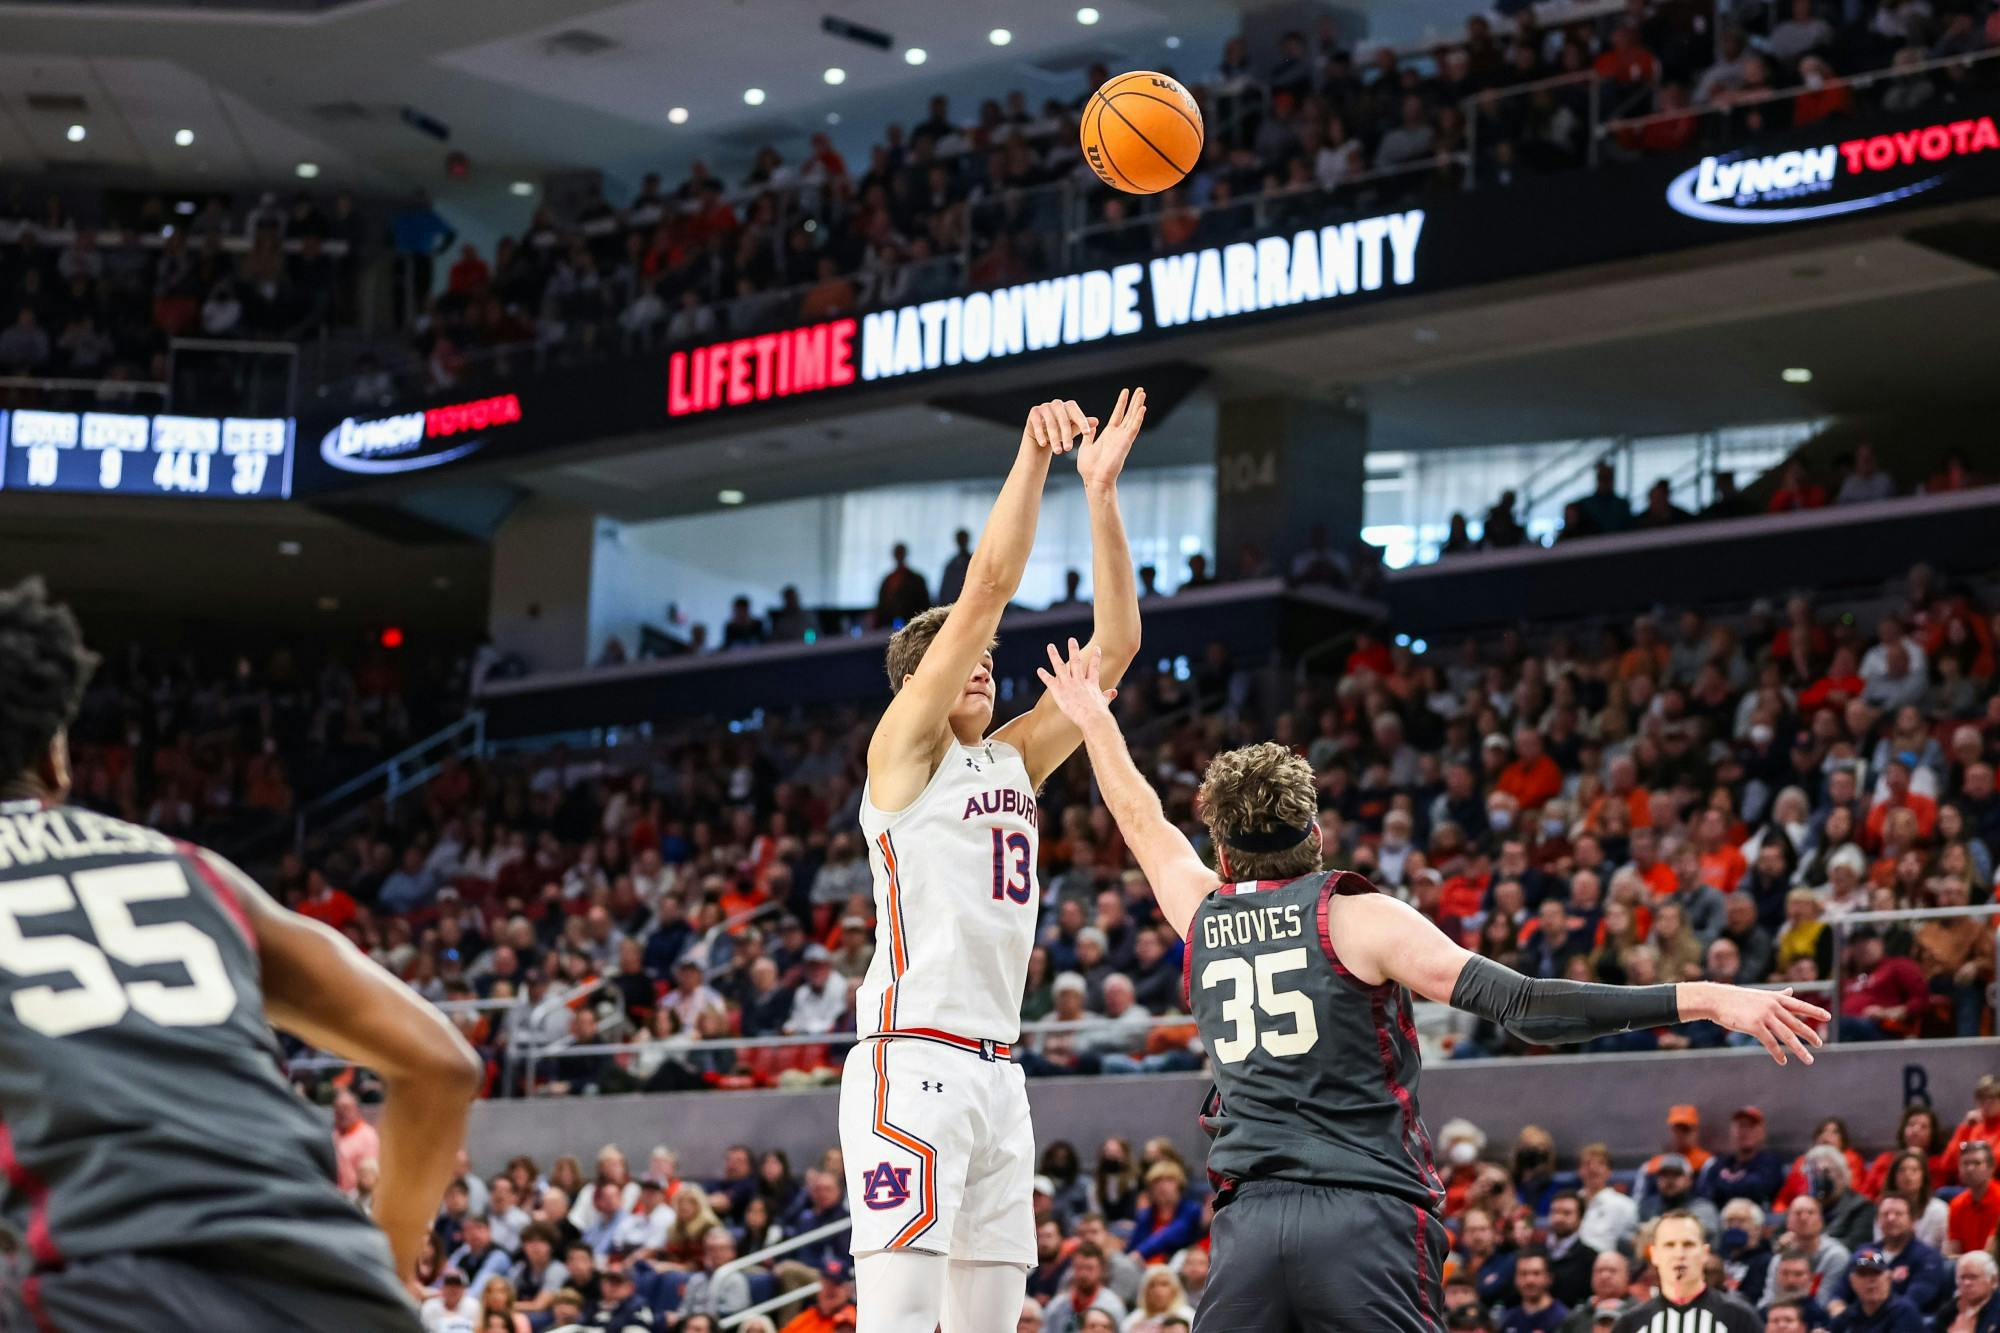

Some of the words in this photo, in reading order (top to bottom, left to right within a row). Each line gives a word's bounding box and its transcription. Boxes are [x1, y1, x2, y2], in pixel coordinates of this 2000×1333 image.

[1696, 145, 1837, 203] LYNCH
[1839, 116, 2000, 174] TOYOTA
[668, 318, 856, 416] LIFETIME
[861, 262, 1144, 381] NATIONWIDE
[1150, 209, 1425, 328] WARRANTY
[425, 393, 521, 438] TOYOTA
[991, 827, 1032, 905] 13
[0, 859, 237, 1039] 55
[1203, 904, 1302, 949] GROVES
[1201, 947, 1319, 1065] 35
